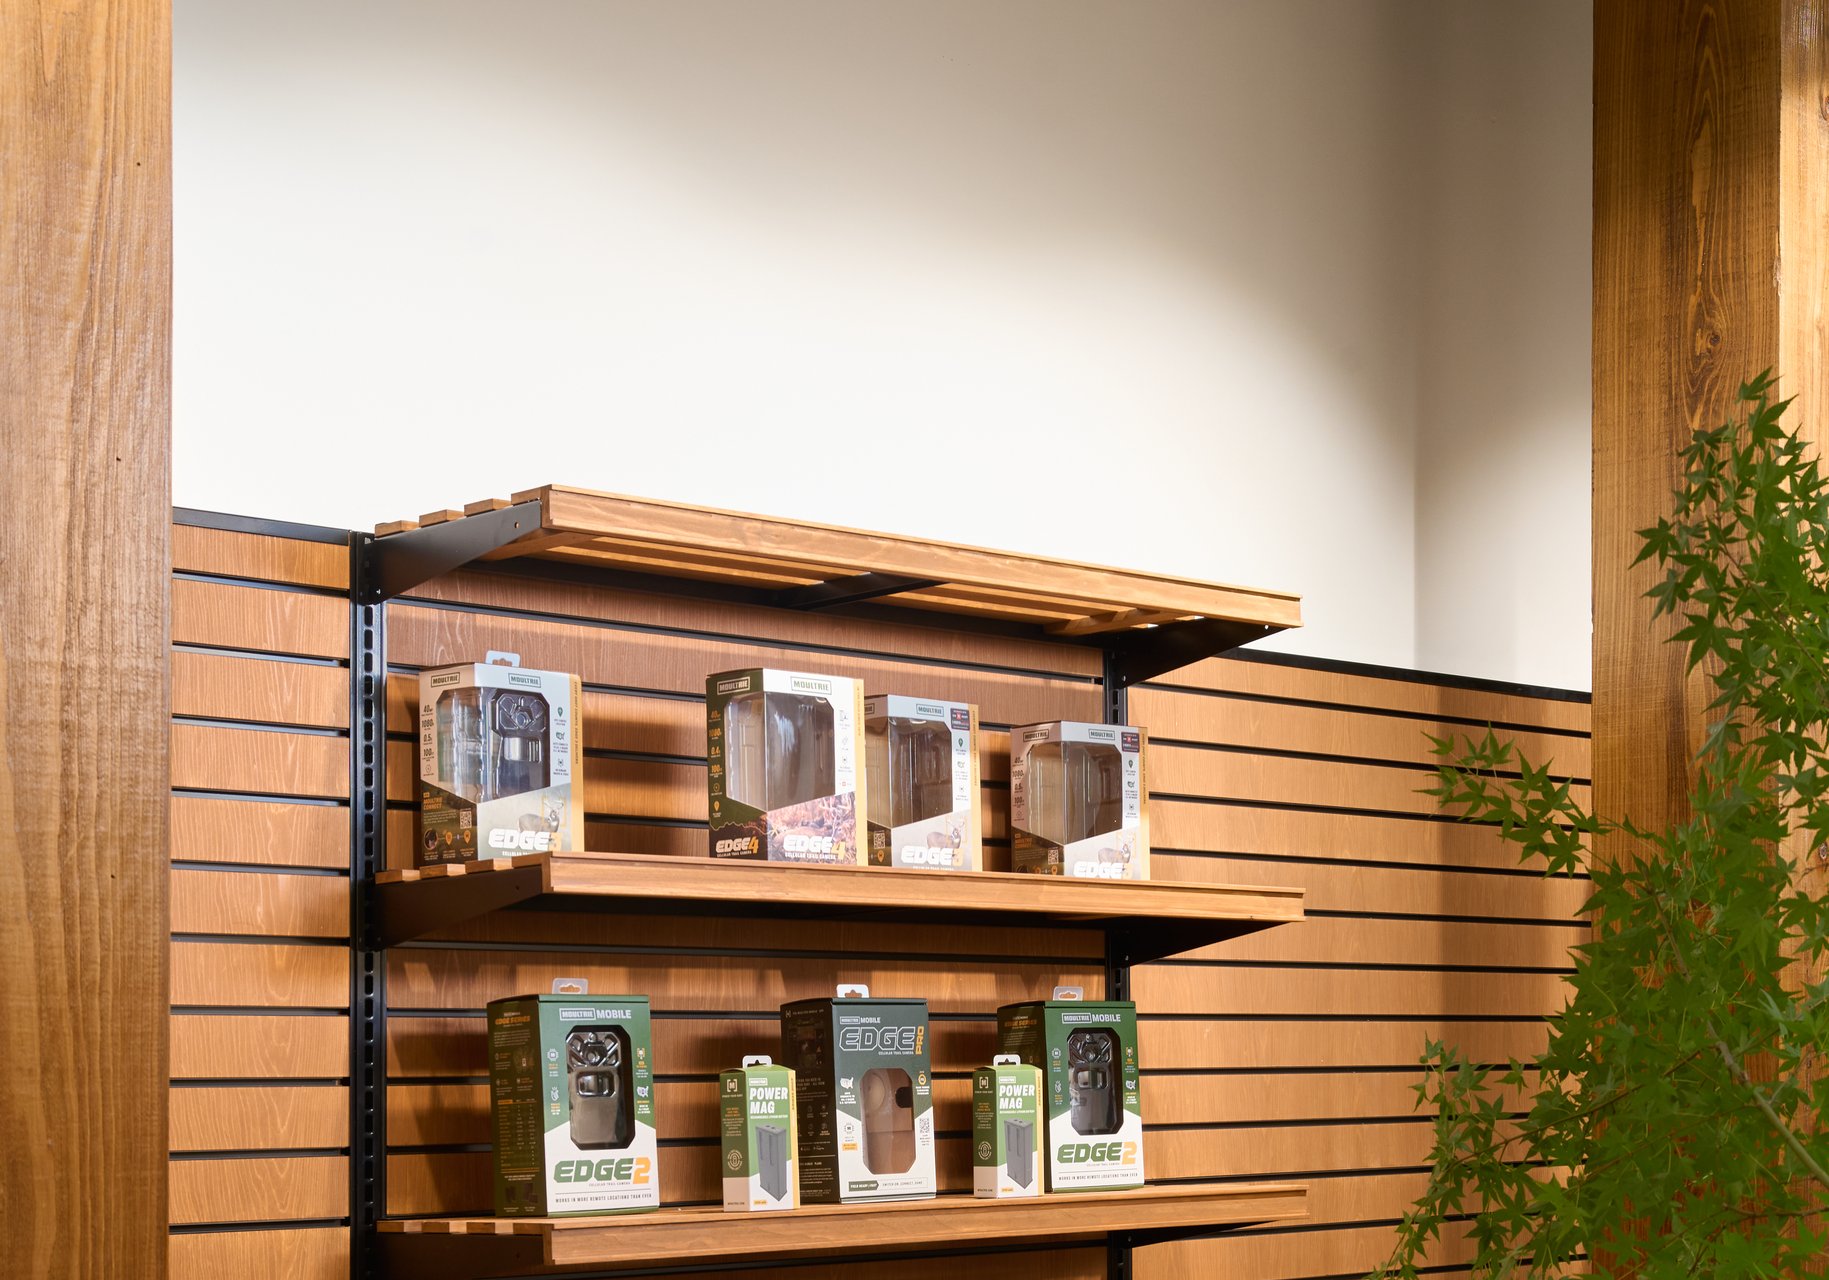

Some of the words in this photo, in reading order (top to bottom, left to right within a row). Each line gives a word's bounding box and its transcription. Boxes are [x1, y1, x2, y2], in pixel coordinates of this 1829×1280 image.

[432, 675, 458, 684] MOULTRIE
[510, 676, 538, 685] MOULTRIE
[720, 680, 748, 691] MOULTRIE
[793, 680, 829, 691] MOULTRIE
[716, 836, 759, 854] EDGE4
[783, 834, 846, 860] EDGE4
[597, 1010, 631, 1019] MOBILE
[1092, 1014, 1121, 1022] MOBILE
[839, 1026, 916, 1051] EDGE
[915, 1026, 924, 1055] PRO
[749, 1087, 788, 1100] POWER
[999, 1085, 1035, 1096] POWER
[750, 1101, 775, 1114] MAG
[1000, 1097, 1023, 1109] MAG
[1057, 1142, 1137, 1165] EDGE2
[554, 1156, 650, 1184] EDGE2
